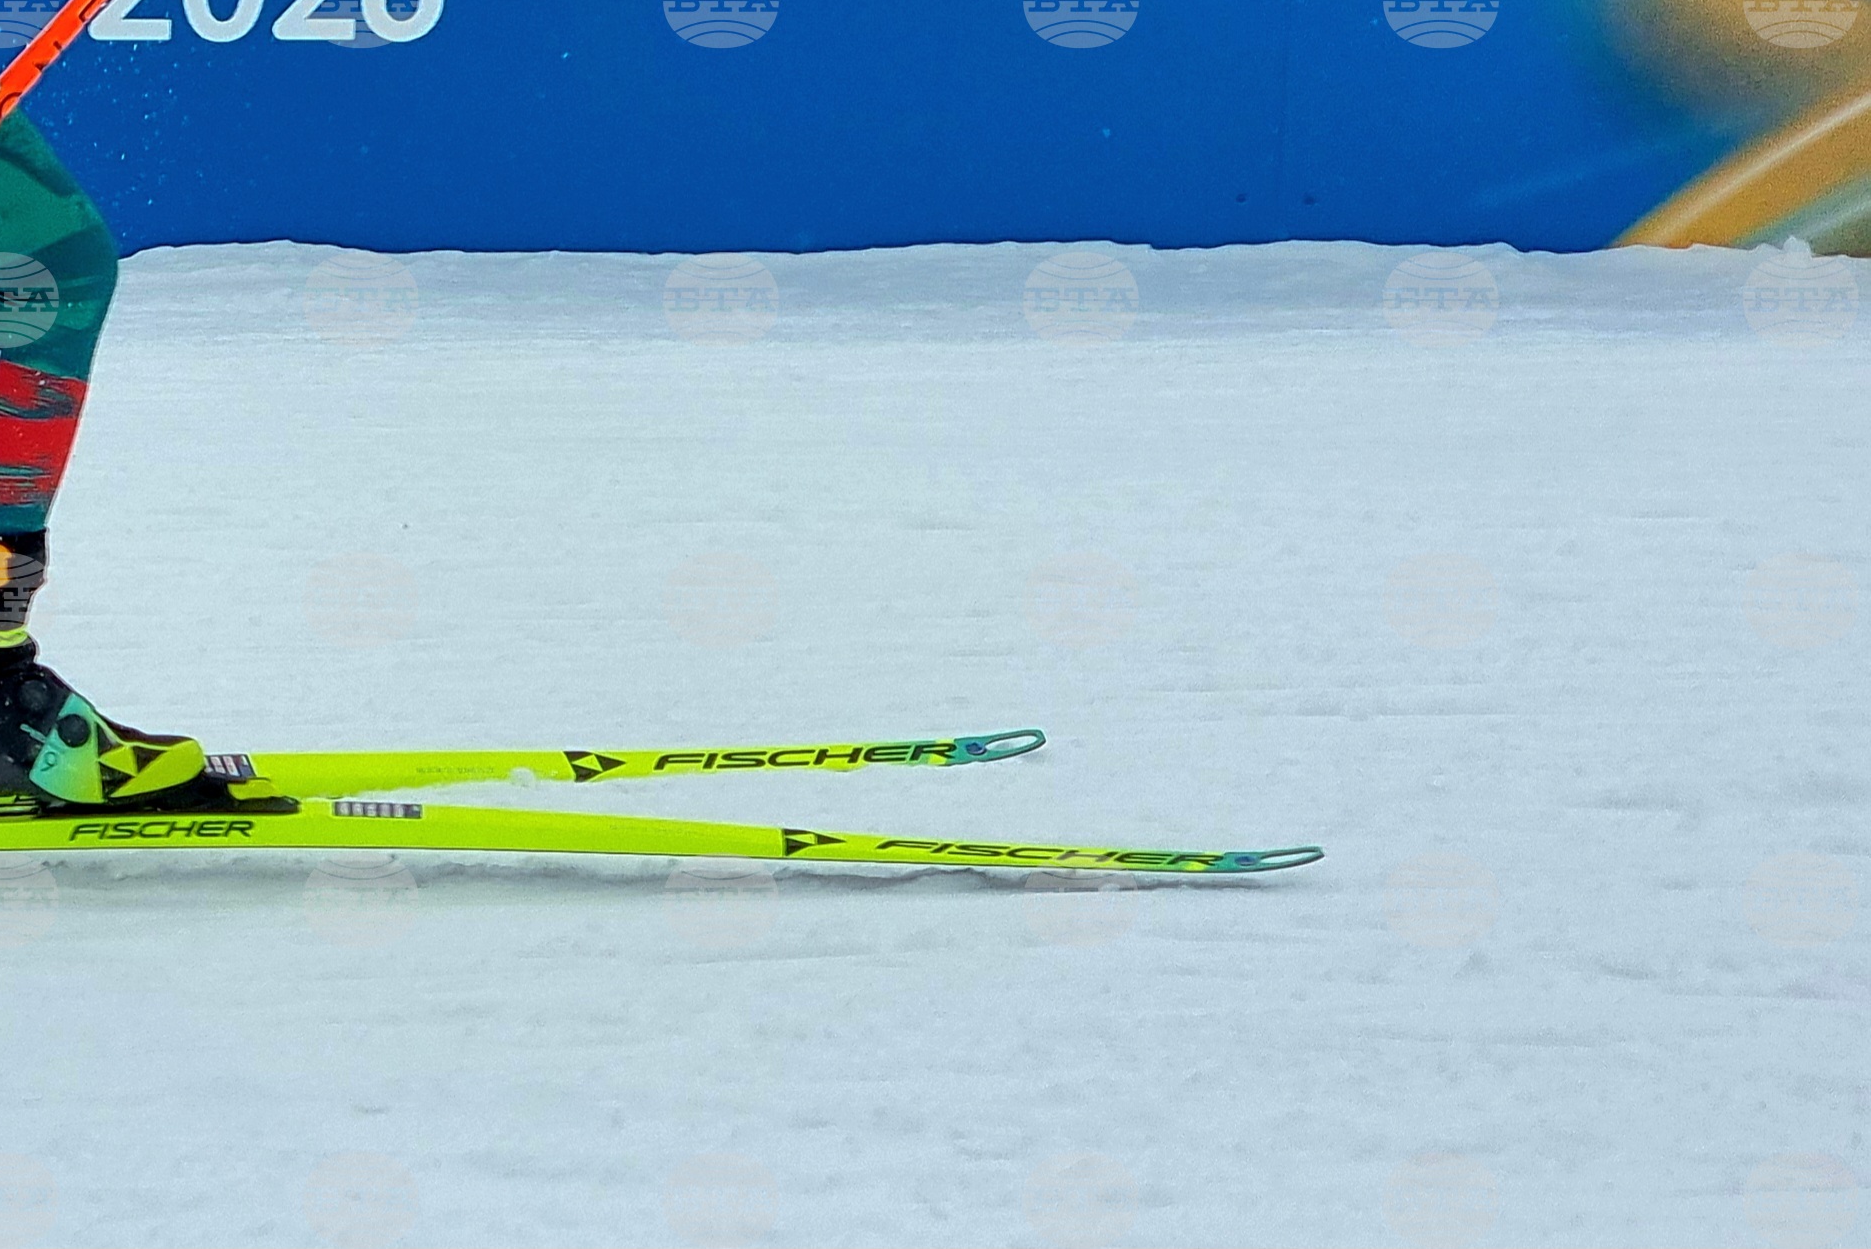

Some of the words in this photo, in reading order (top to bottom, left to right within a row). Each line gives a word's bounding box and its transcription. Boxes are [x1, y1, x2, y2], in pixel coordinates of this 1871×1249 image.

[653, 740, 958, 771] FISCHER
[69, 820, 256, 842] FISCHER
[875, 839, 1230, 868] FISCHER
